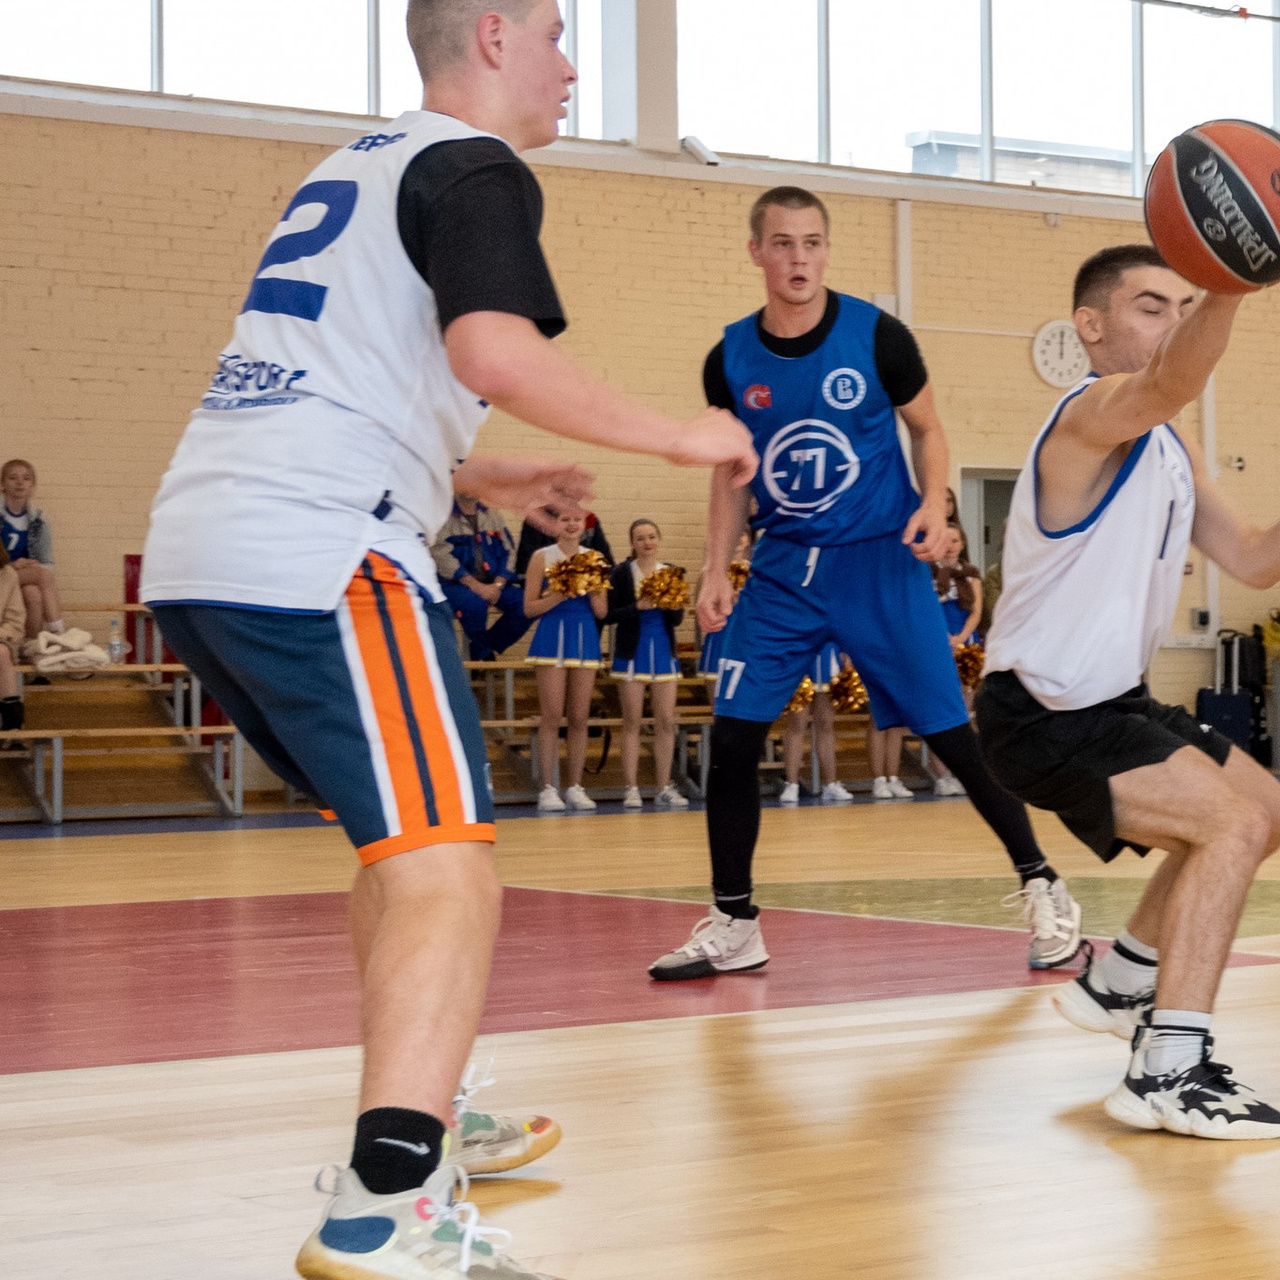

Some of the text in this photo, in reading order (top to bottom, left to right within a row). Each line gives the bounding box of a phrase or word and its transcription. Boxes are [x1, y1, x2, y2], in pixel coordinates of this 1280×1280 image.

[240, 179, 359, 322] 2
[1191, 153, 1277, 271] SPALDING
[789, 447, 828, 491] 77
